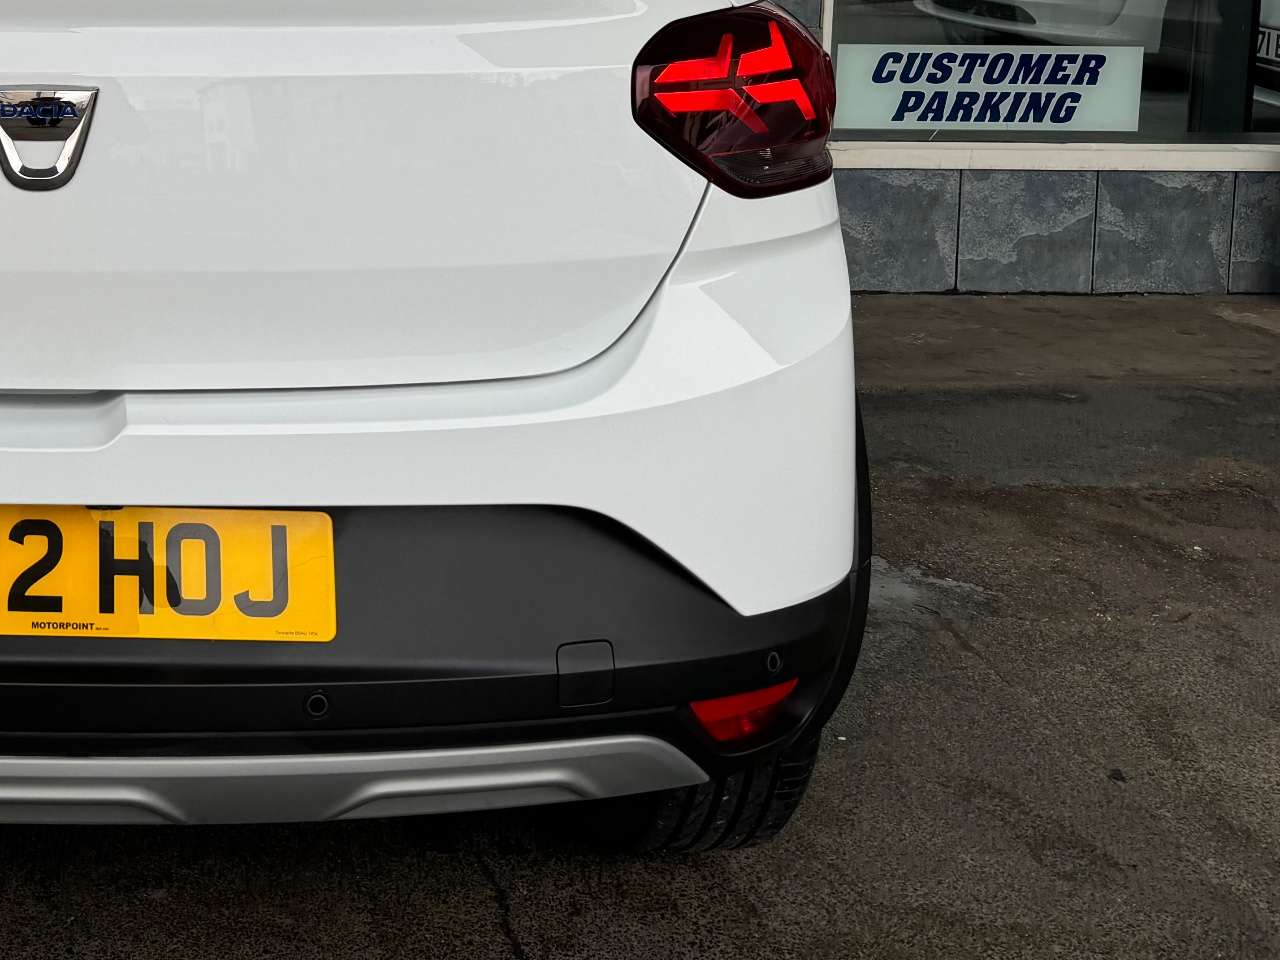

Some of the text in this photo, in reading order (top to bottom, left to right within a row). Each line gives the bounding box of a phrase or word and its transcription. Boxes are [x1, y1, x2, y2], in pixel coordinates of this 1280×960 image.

[871, 52, 1106, 86] CUSTOMER
[0, 103, 81, 119] DACIA
[891, 91, 1082, 123] PARKING
[98, 520, 289, 618] HOJ
[31, 621, 94, 631] MOTORPOINT
